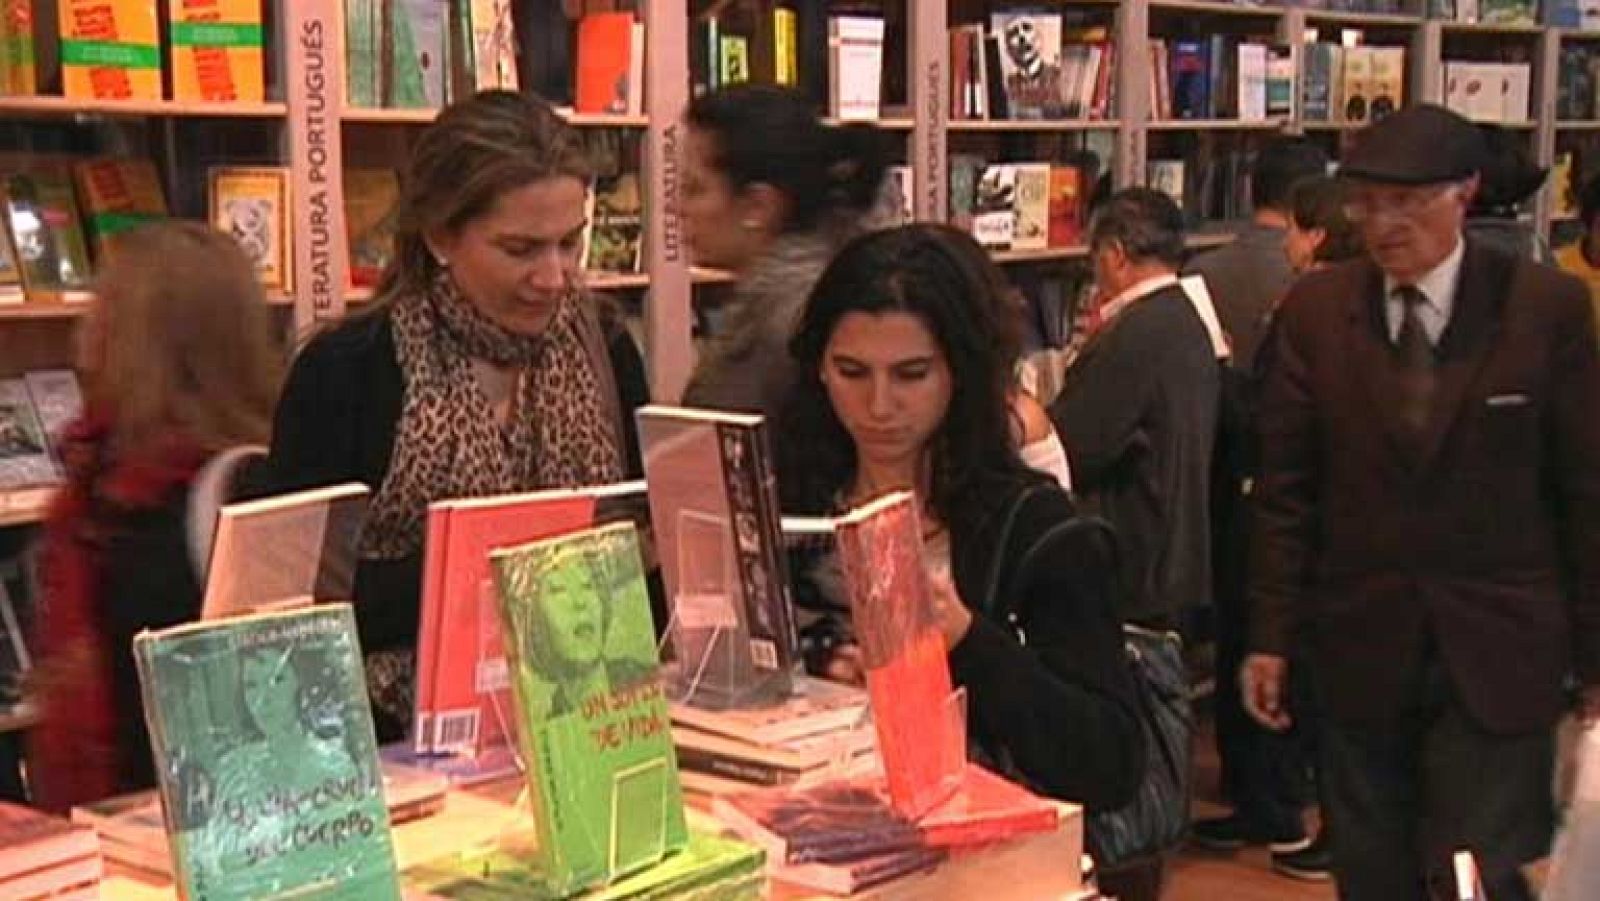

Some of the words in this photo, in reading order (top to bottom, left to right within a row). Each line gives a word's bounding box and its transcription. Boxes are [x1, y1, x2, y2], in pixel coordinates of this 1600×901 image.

[302, 18, 326, 183] PORTUGUÉS
[311, 190, 331, 321] TERATURA
[663, 123, 679, 261] LITERATURA
